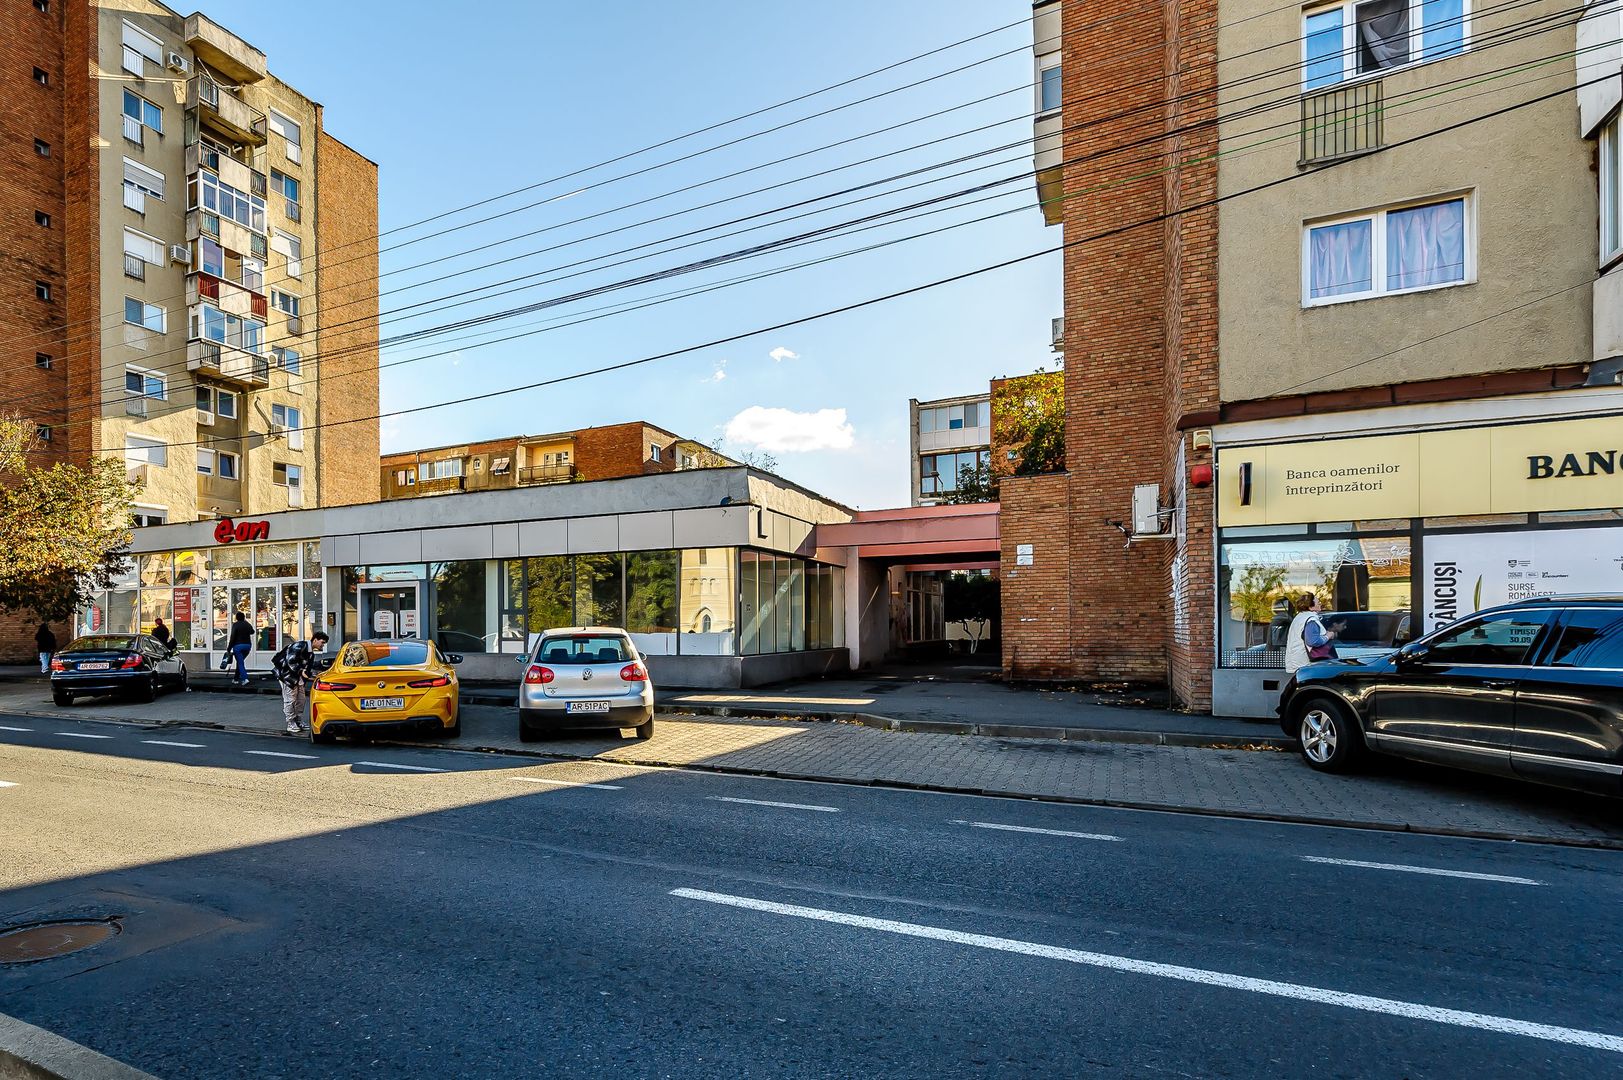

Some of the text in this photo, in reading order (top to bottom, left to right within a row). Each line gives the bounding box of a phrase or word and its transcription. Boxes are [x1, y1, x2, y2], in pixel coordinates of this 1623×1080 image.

[1286, 463, 1400, 480] Banca oamenilor
[1526, 450, 1623, 479] BAN
[1285, 480, 1383, 495] întreprinzători
[571, 703, 583, 711] AR
